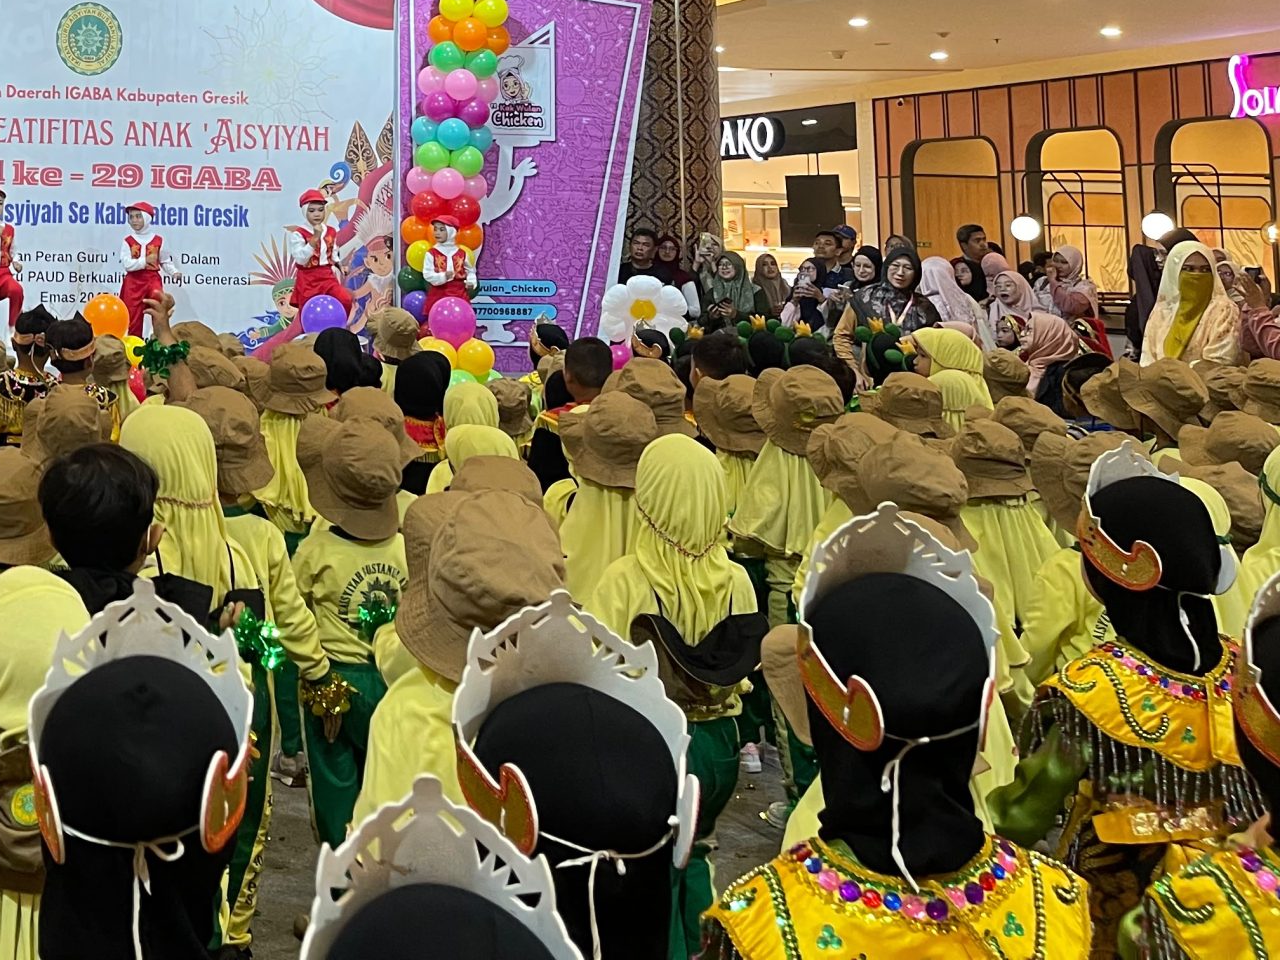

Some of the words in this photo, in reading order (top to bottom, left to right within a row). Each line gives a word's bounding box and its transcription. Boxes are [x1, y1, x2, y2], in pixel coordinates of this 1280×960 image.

[6, 84, 61, 100] Daerah
[65, 86, 112, 101] IGABA
[117, 87, 198, 106] Kabupaten
[202, 90, 249, 106] Gresik
[492, 110, 543, 127] Chicken
[124, 121, 193, 148] ANAK
[12, 160, 63, 187] ke
[92, 163, 144, 189] 29
[151, 165, 282, 192] IGABA
[69, 201, 89, 224] Se
[95, 202, 188, 226] Kabaten
[194, 204, 250, 228] Gresik
[35, 251, 73, 263] Peran
[77, 251, 108, 263] Guru
[181, 253, 220, 265] Dalam
[28, 271, 64, 283] PAUD
[69, 271, 126, 284] Berkualit
[194, 273, 251, 286] Generasi
[40, 291, 76, 303] Emas
